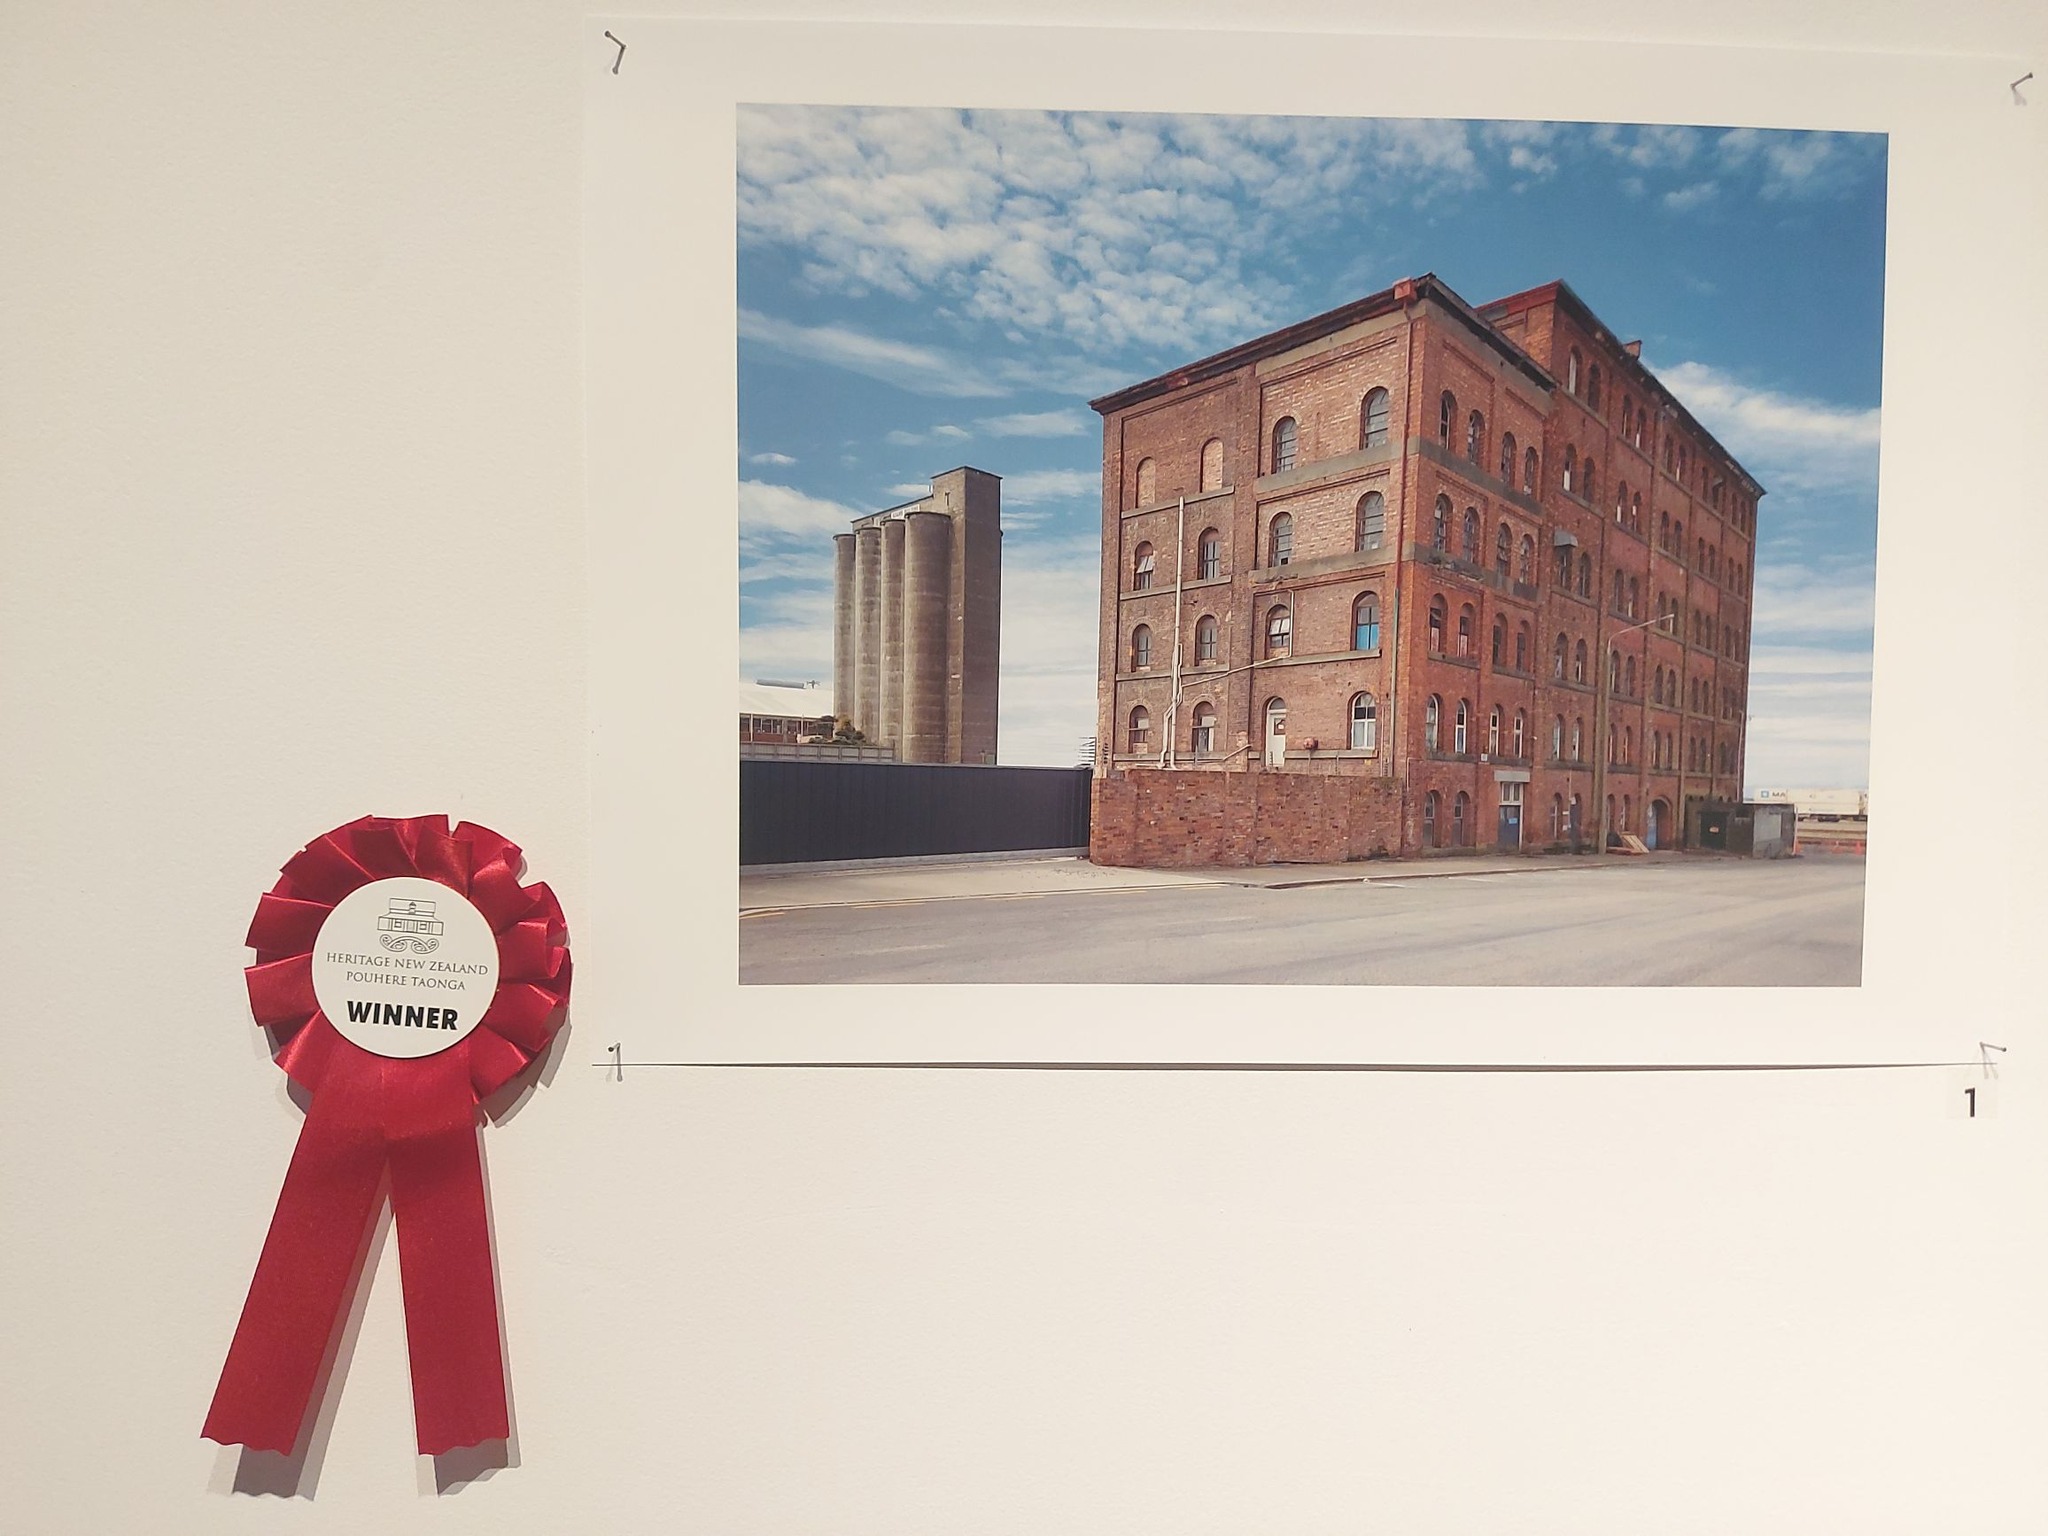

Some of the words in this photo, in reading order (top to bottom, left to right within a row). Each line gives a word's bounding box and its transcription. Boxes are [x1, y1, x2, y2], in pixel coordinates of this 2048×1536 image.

[327, 952, 390, 967] HERITAGE
[394, 958, 425, 970] NEW
[429, 961, 488, 975] ZEALAND
[346, 971, 407, 986] POUHERE
[411, 976, 466, 990] TAONGA
[347, 1000, 458, 1030] WINNER
[1964, 1087, 1976, 1117] 1
